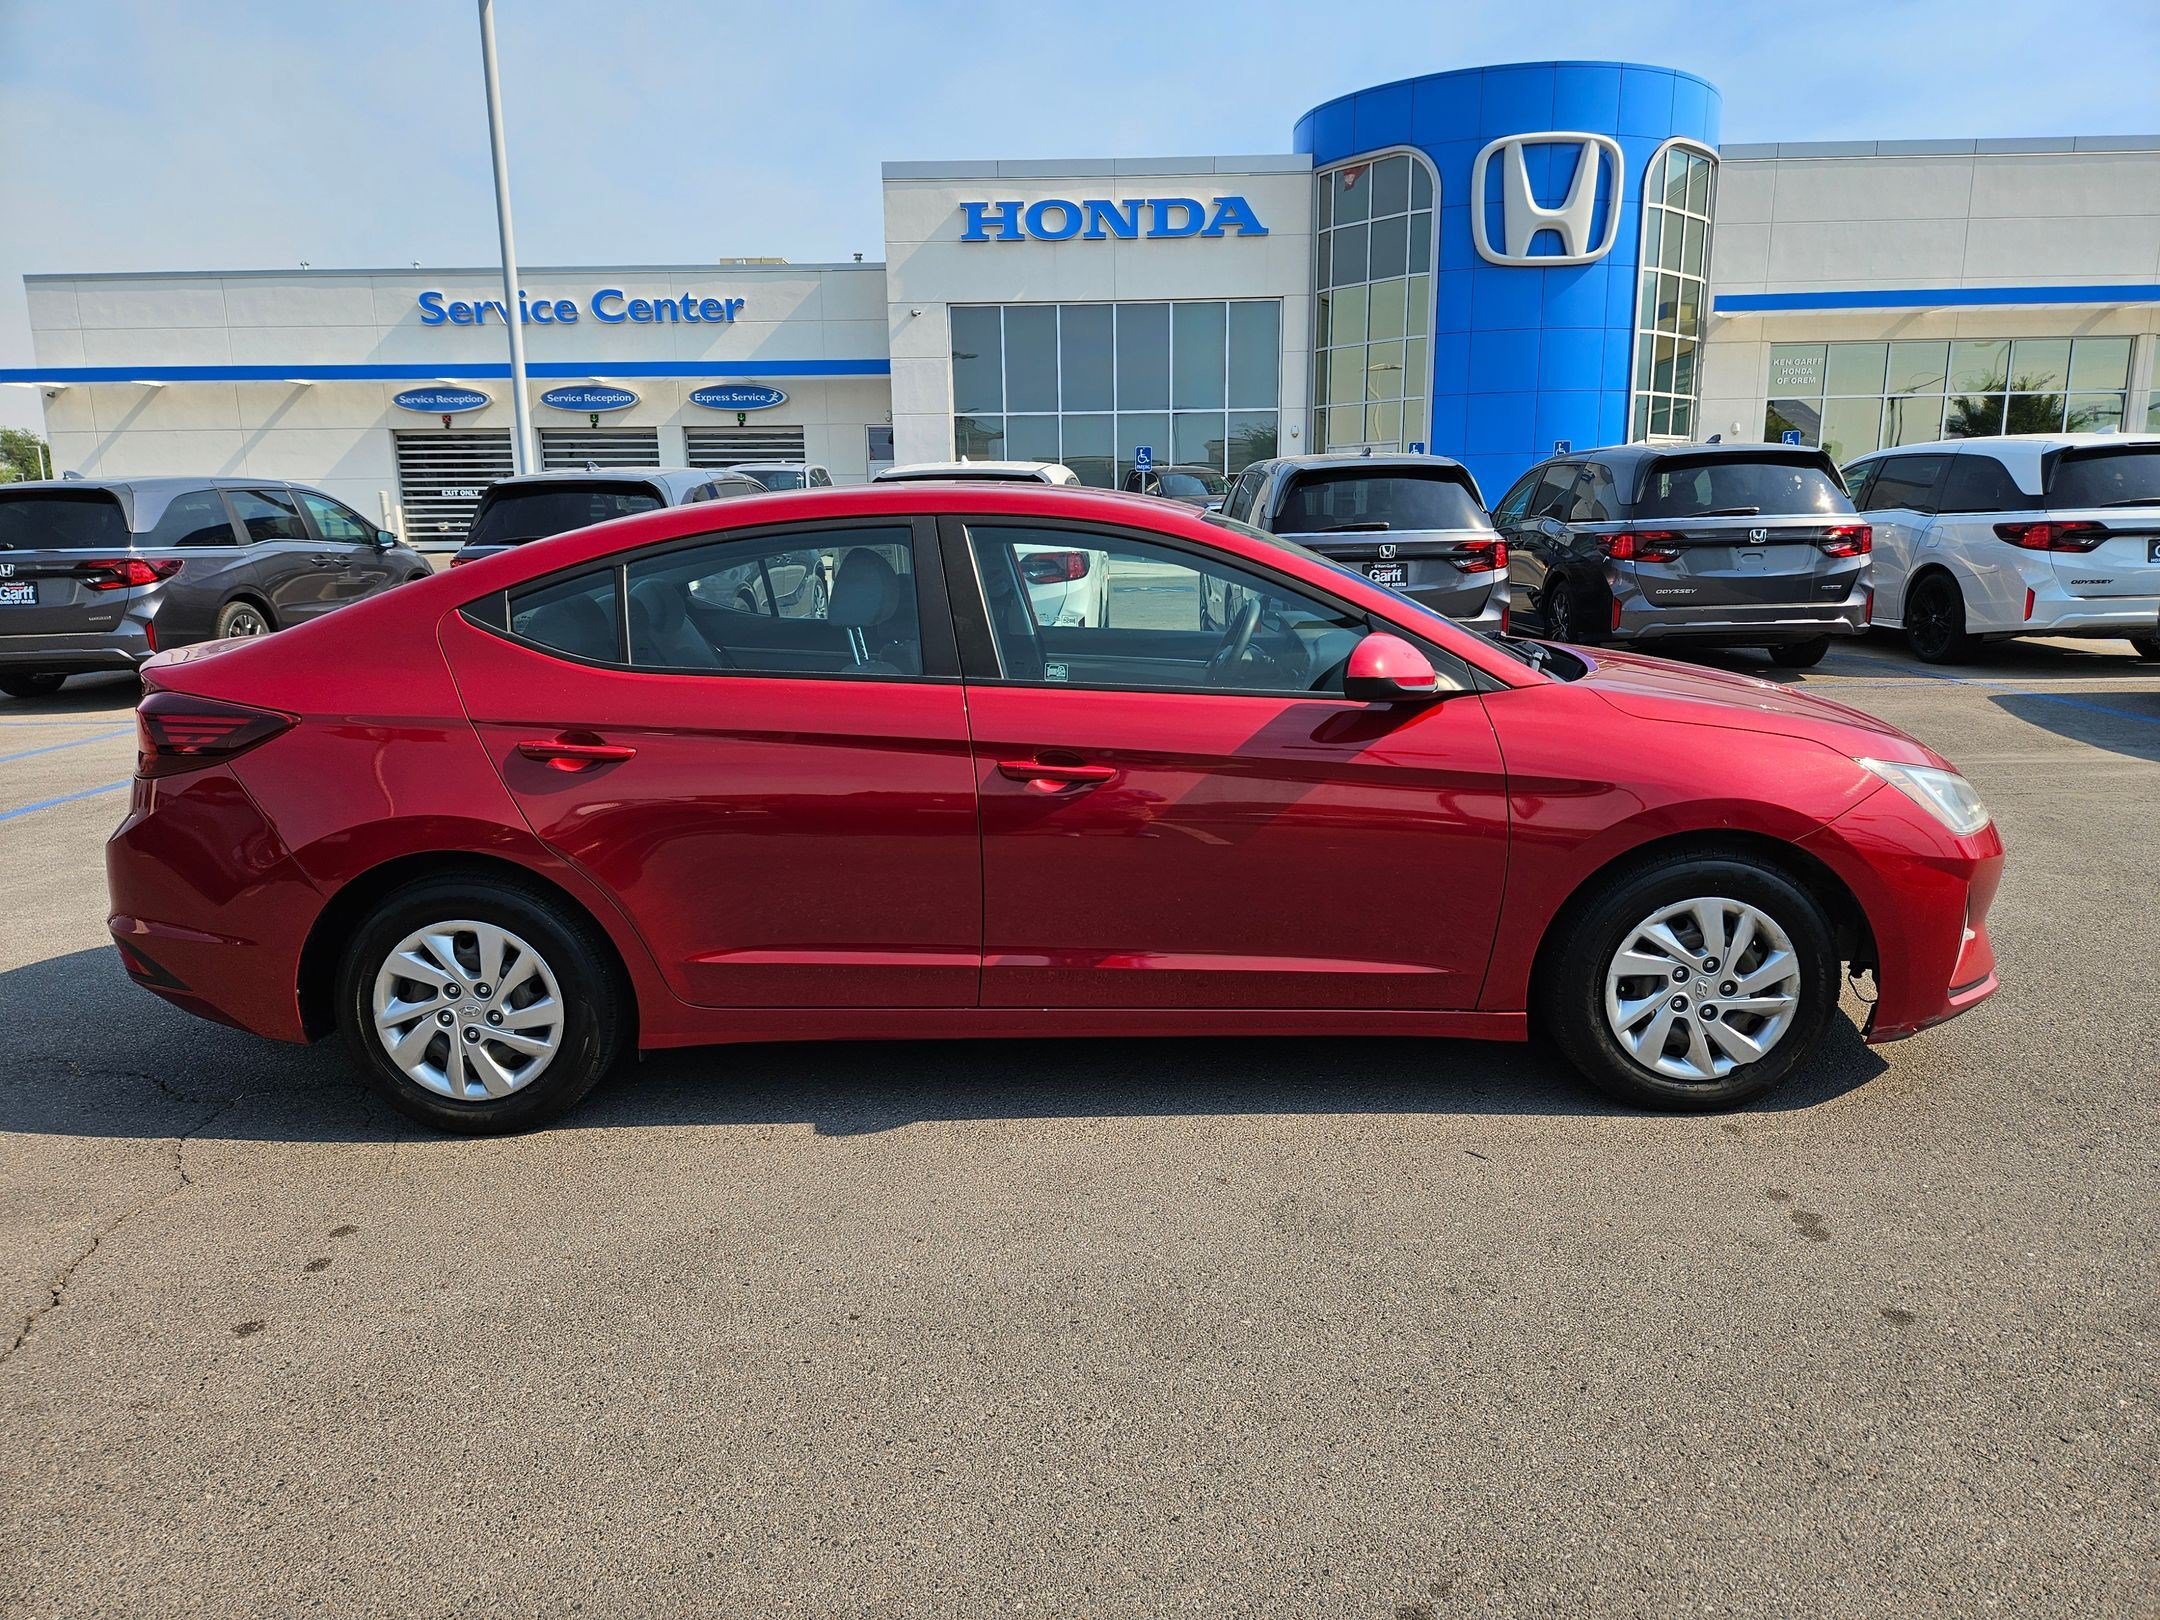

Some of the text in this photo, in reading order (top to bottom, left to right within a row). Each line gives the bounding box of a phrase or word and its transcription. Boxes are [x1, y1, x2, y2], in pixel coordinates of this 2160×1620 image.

[960, 196, 1269, 242] HONDA
[590, 288, 745, 324] Center
[1782, 367, 1813, 375] HONDA
[1776, 376, 1817, 385] OF OREM
[400, 394, 484, 405] Service Reception
[547, 393, 632, 404] Service Reception
[694, 393, 766, 403] Express Service
[1369, 569, 1402, 582] Garff
[0, 586, 34, 601] Garff
